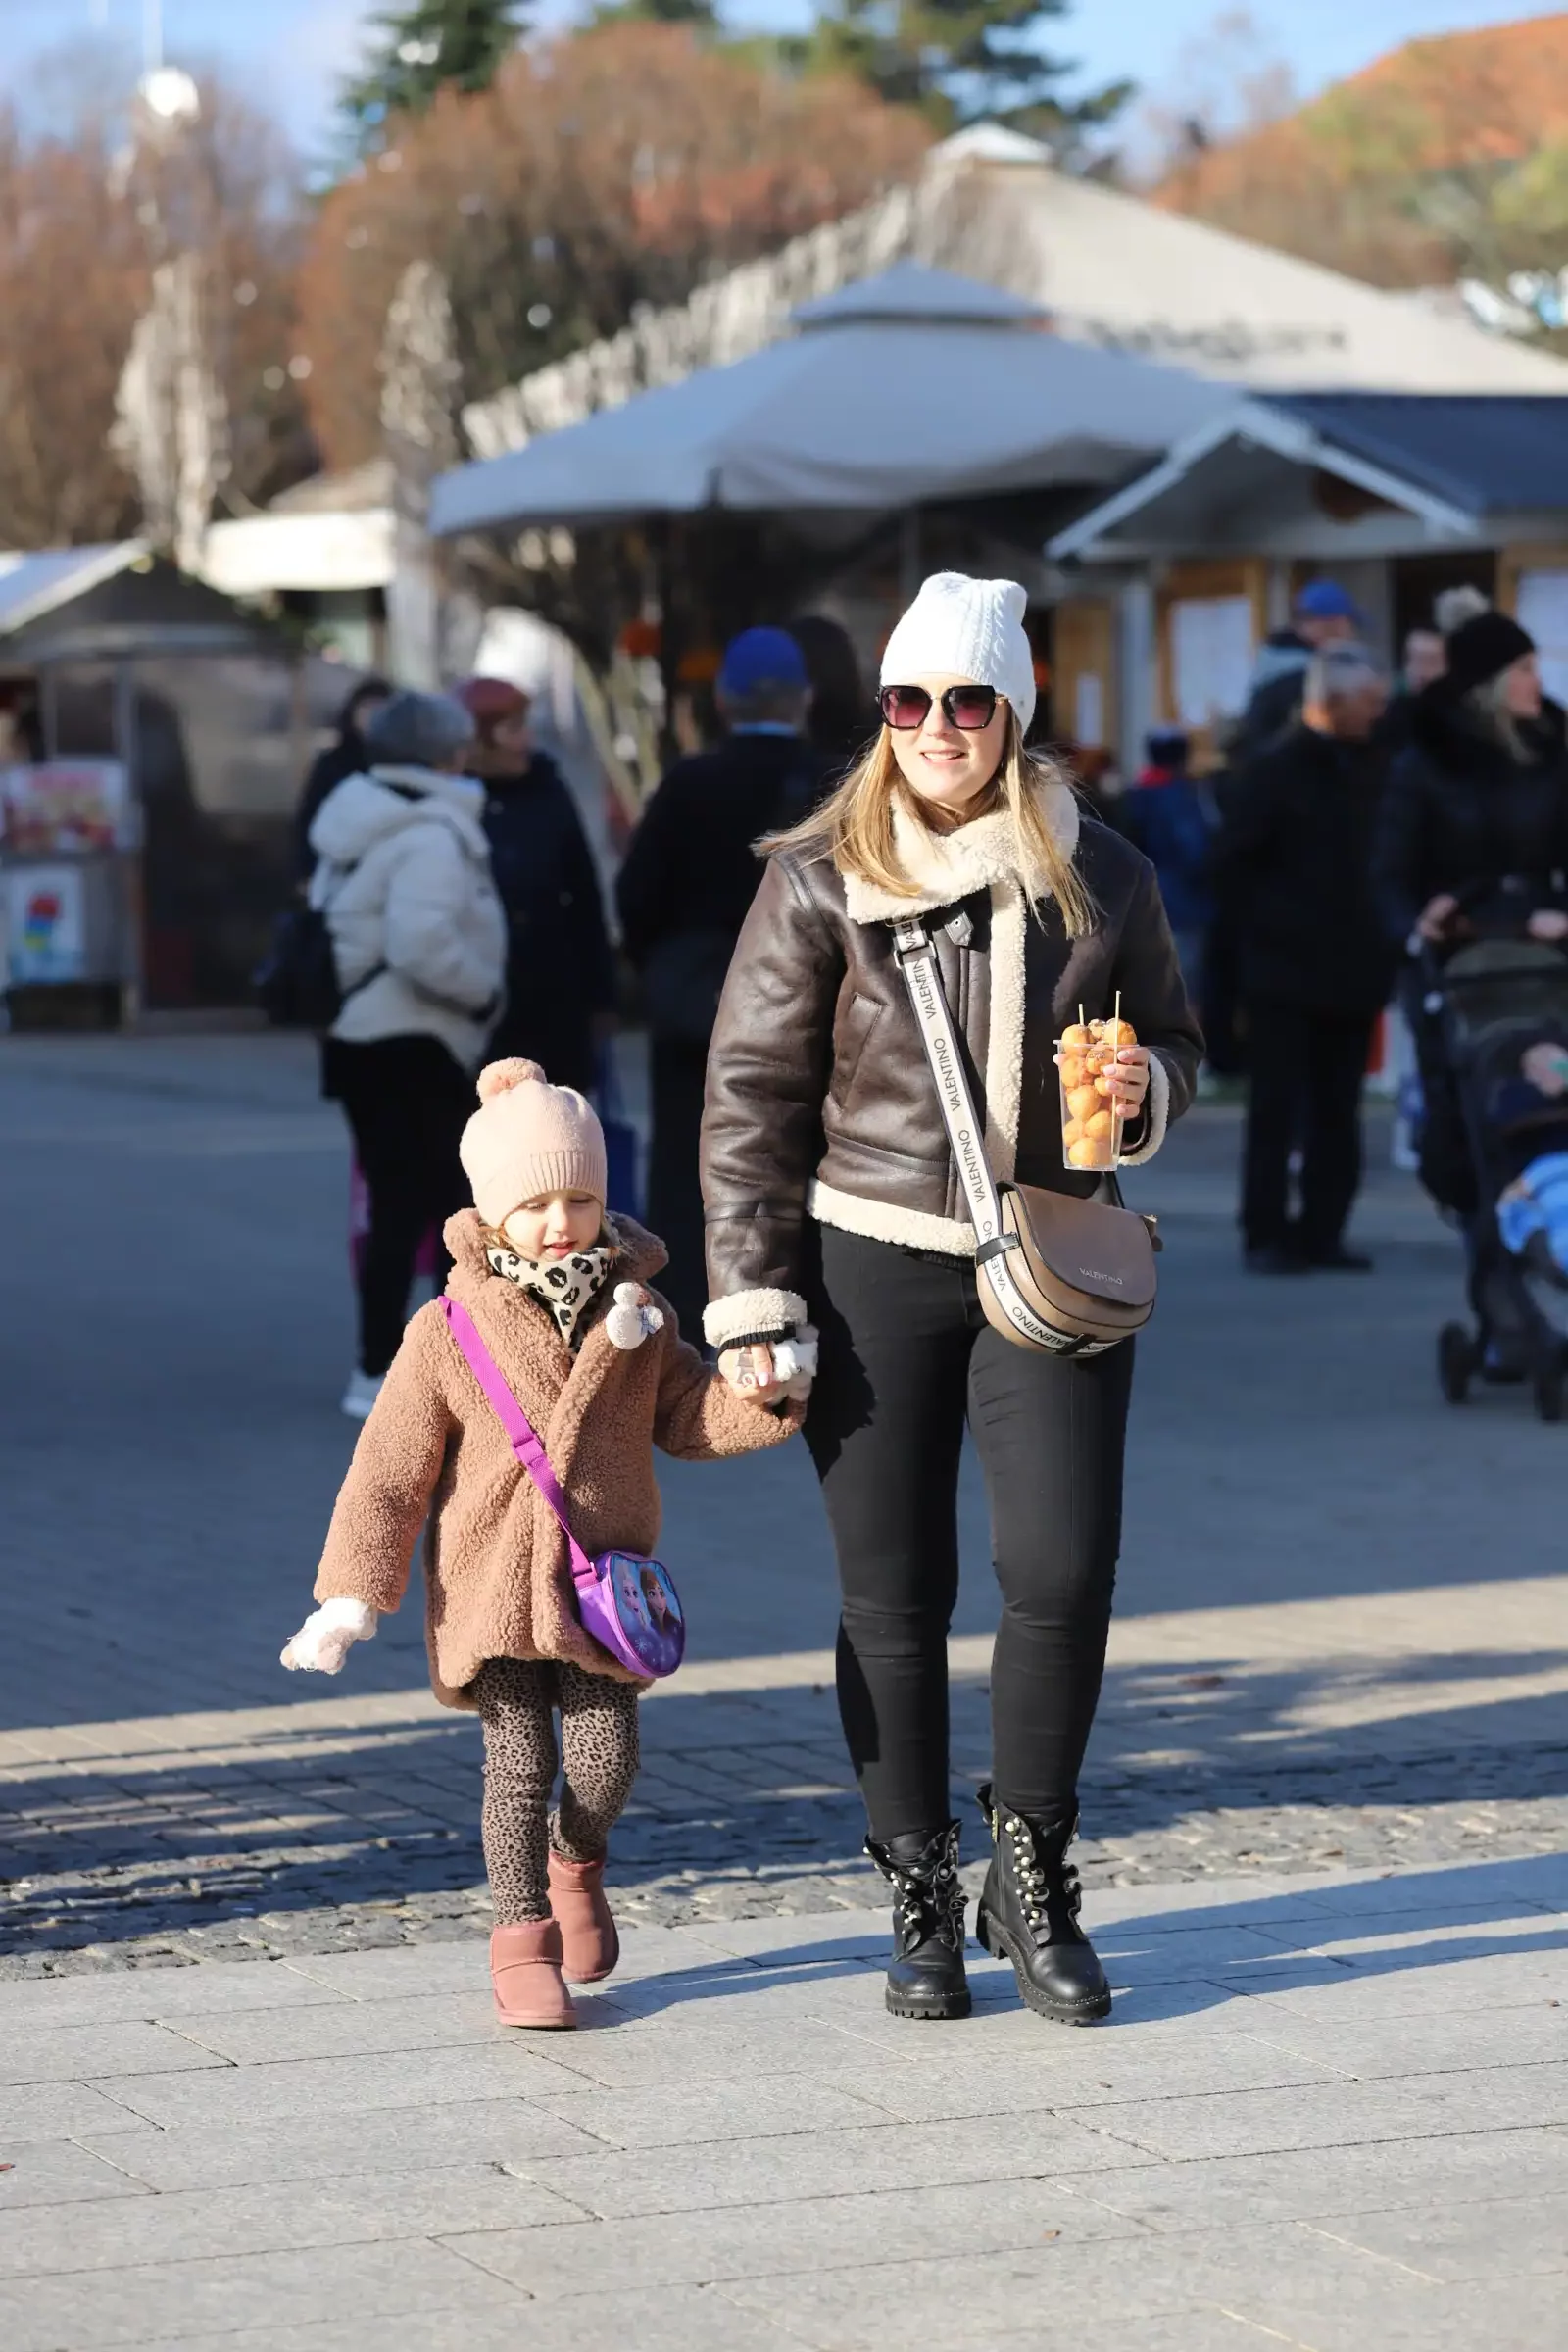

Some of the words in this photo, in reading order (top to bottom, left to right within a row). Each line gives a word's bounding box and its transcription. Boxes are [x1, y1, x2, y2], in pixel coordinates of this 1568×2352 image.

[912, 959, 938, 1020] VALENTIN
[934, 1038, 961, 1111] VALENTINO
[958, 1129, 986, 1203] VALENTINO
[1079, 1267, 1123, 1285] VALENTINO
